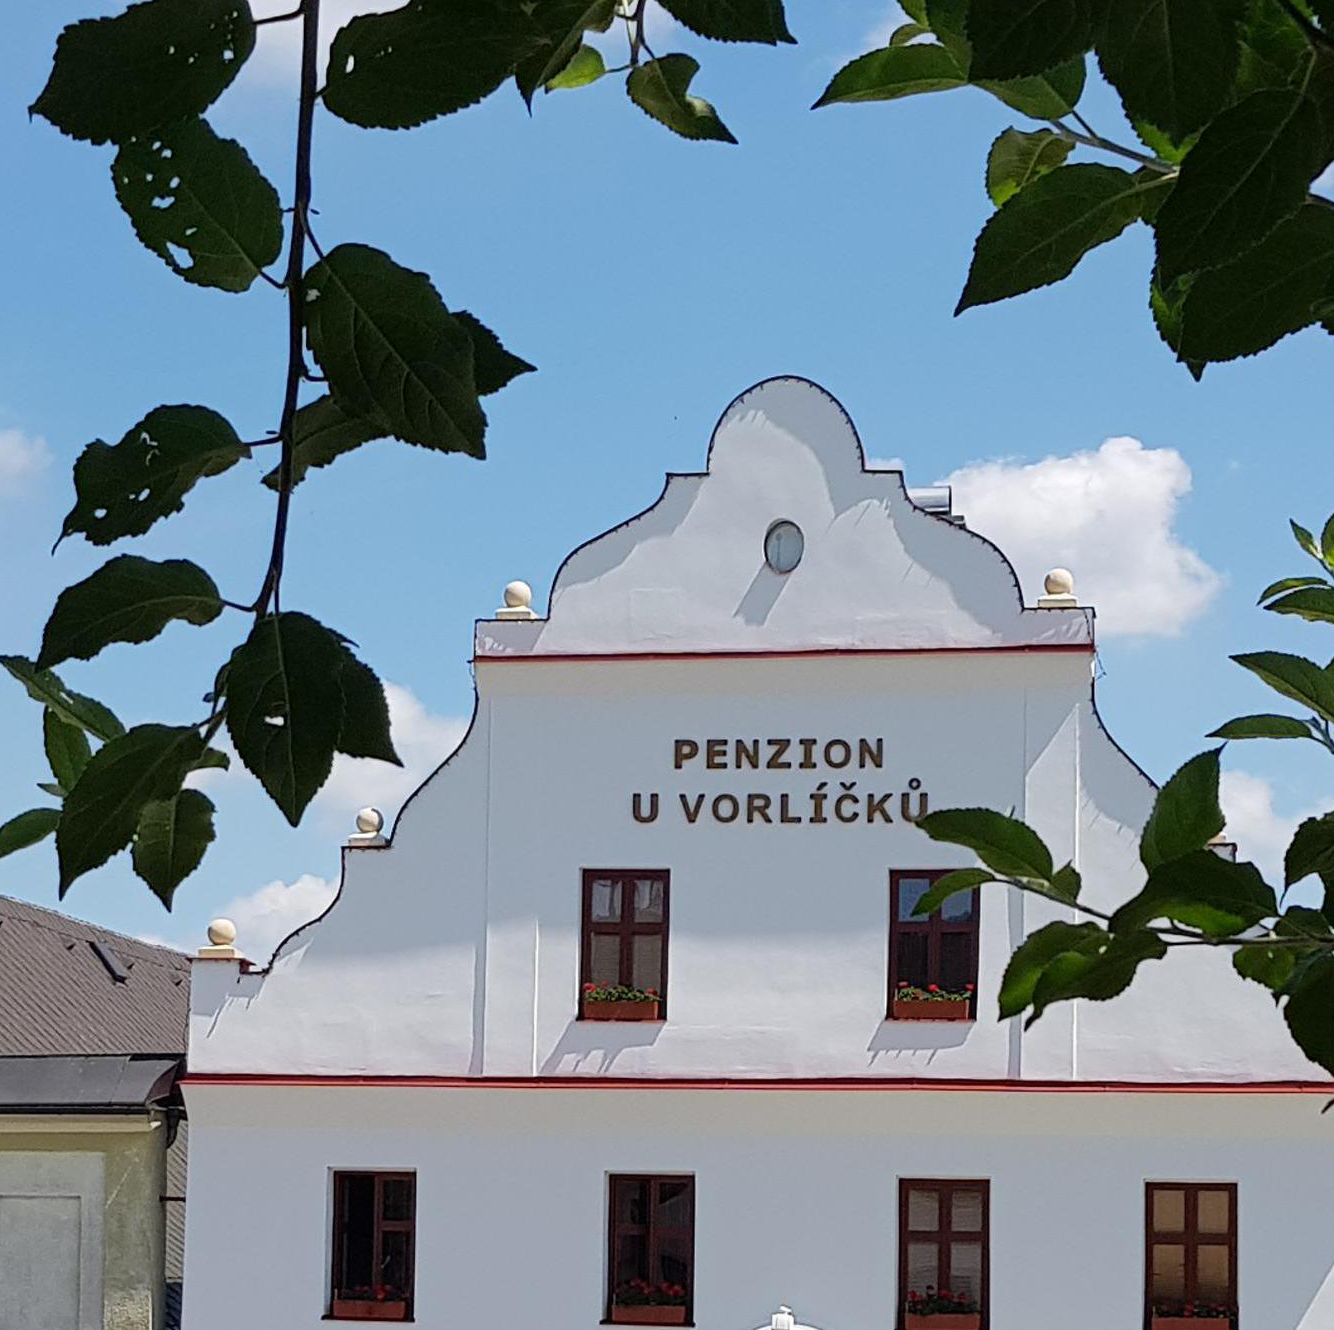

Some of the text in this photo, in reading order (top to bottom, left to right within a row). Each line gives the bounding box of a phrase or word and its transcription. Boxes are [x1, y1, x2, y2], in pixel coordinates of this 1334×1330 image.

[674, 738, 884, 770] PENZION
[632, 778, 929, 824] U VORLÍČKŮ
